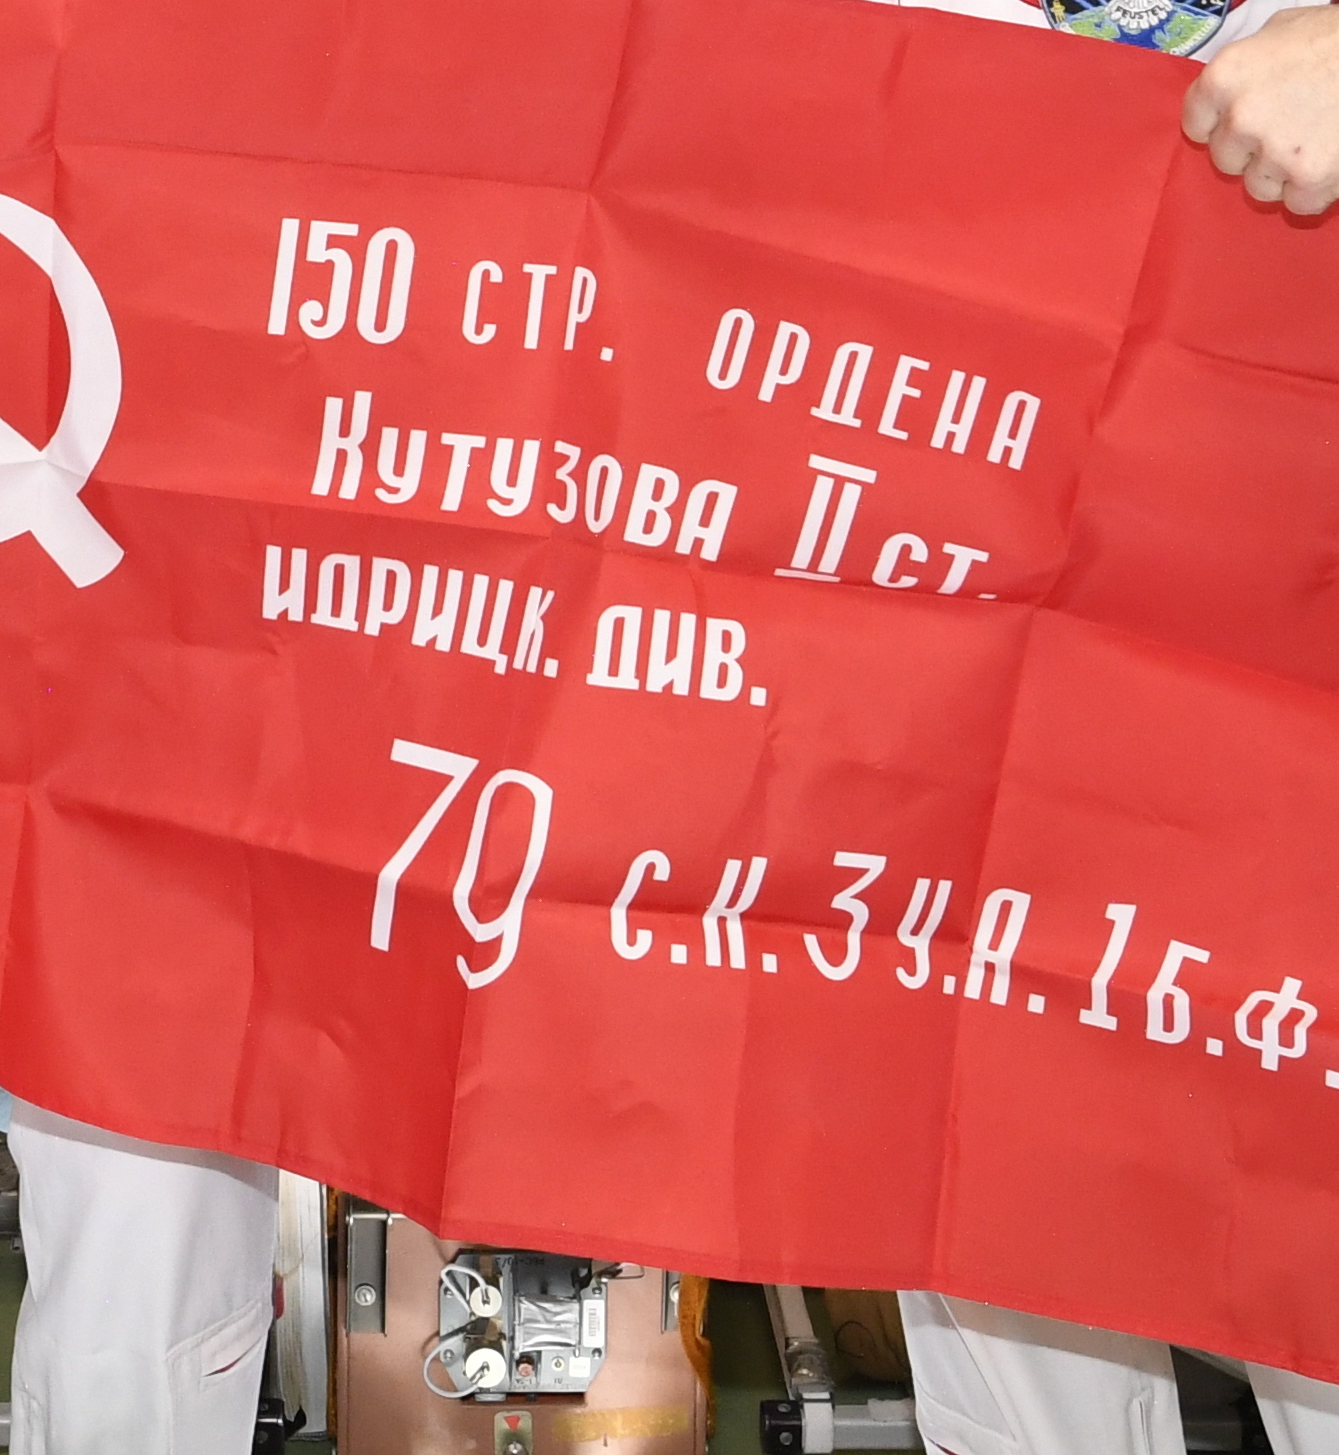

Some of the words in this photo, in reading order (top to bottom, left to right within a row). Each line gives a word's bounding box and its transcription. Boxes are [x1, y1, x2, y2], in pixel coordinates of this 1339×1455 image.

[1115, 4, 1167, 20] FEUSTEL
[268, 218, 415, 344] 150
[371, 739, 553, 989] 79
